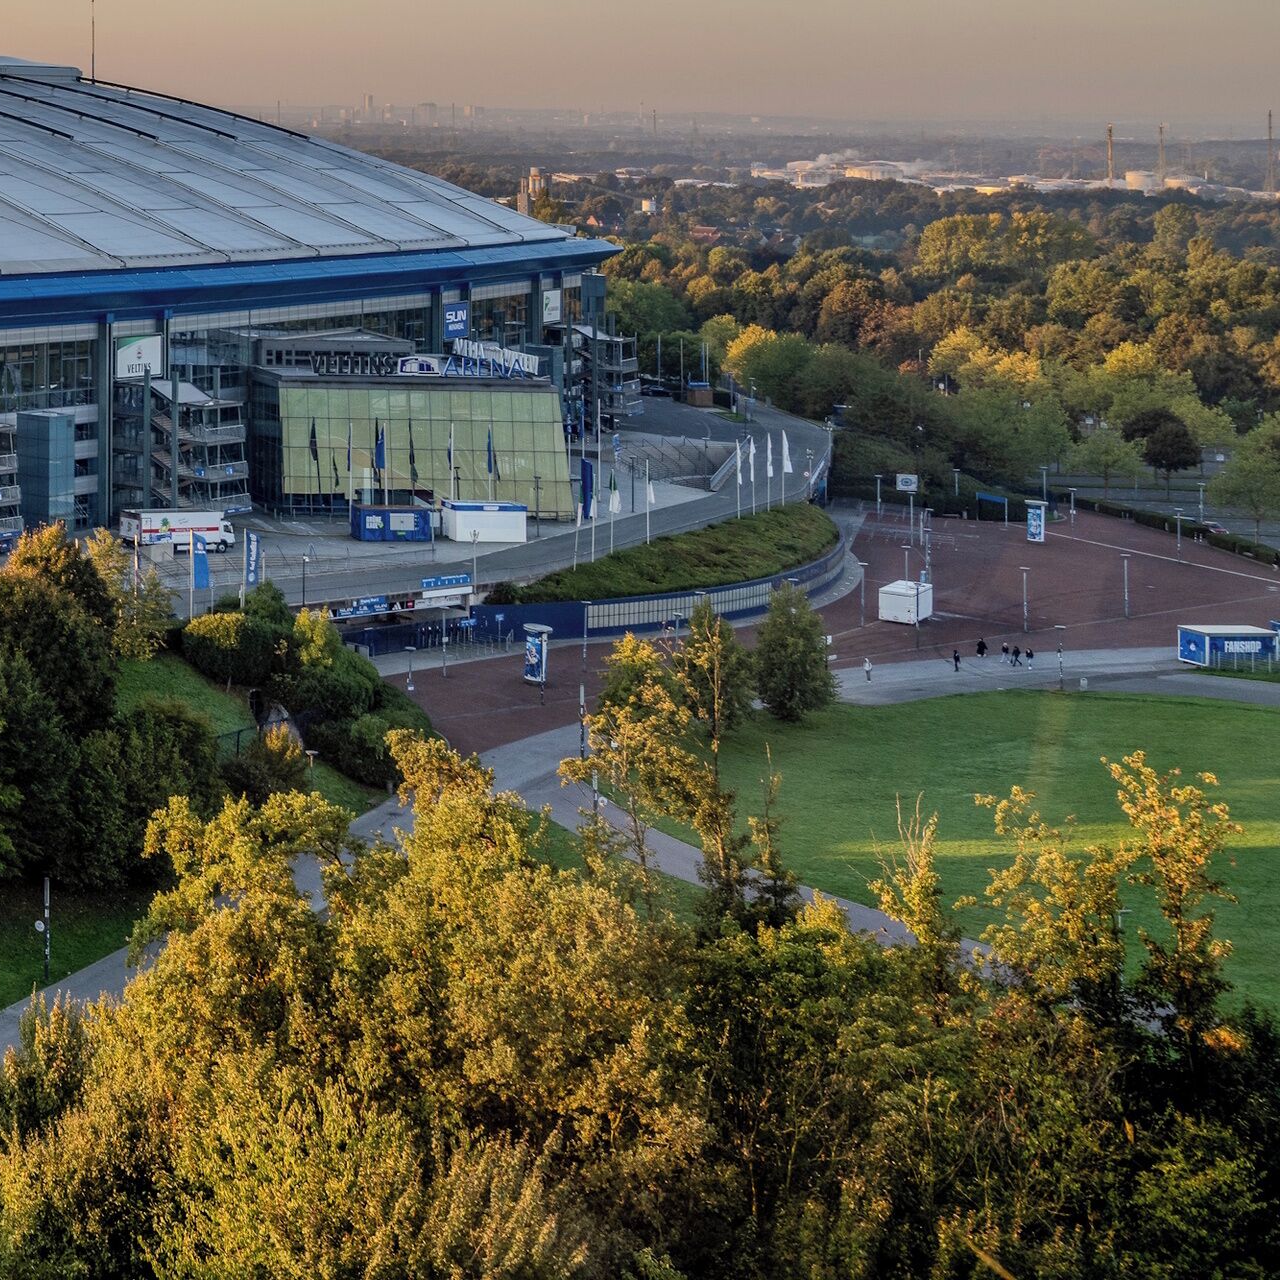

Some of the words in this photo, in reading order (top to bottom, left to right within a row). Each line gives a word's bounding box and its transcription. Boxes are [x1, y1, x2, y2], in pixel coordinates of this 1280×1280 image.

[446, 310, 467, 322] SUN
[127, 363, 151, 373] VELTINS
[308, 353, 393, 376] VELTINS
[443, 356, 527, 379] ARENA
[1224, 640, 1262, 653] FANSHOP
